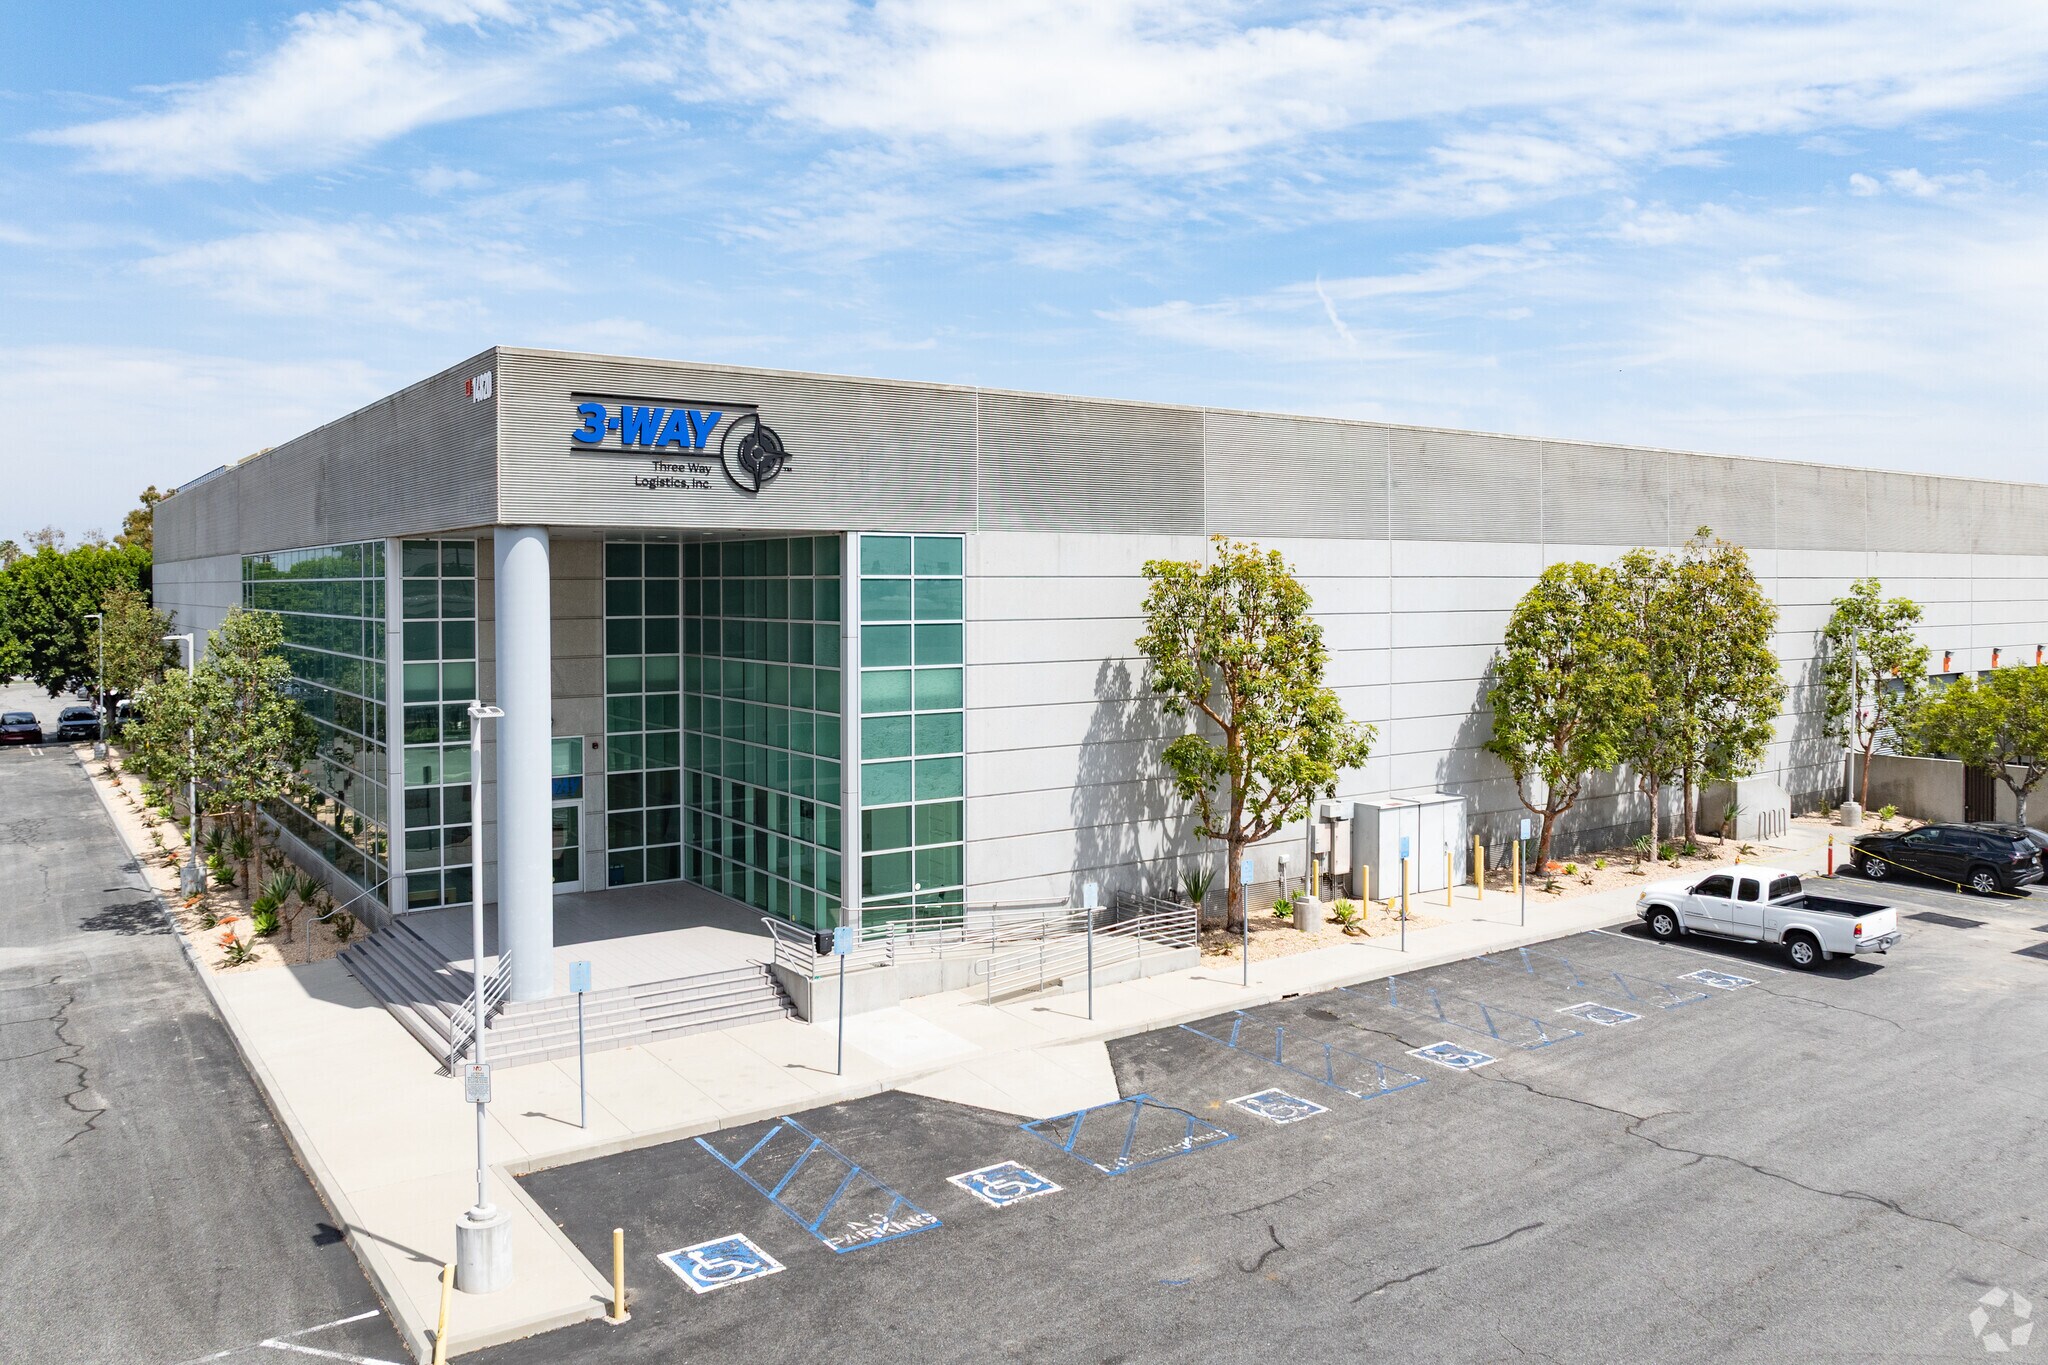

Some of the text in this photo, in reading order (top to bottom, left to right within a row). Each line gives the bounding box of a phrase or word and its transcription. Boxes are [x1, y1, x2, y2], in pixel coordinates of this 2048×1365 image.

[572, 402, 723, 449] 3-WAY
[652, 460, 712, 476] Three Way
[634, 474, 713, 490] Logistics, Inc.
